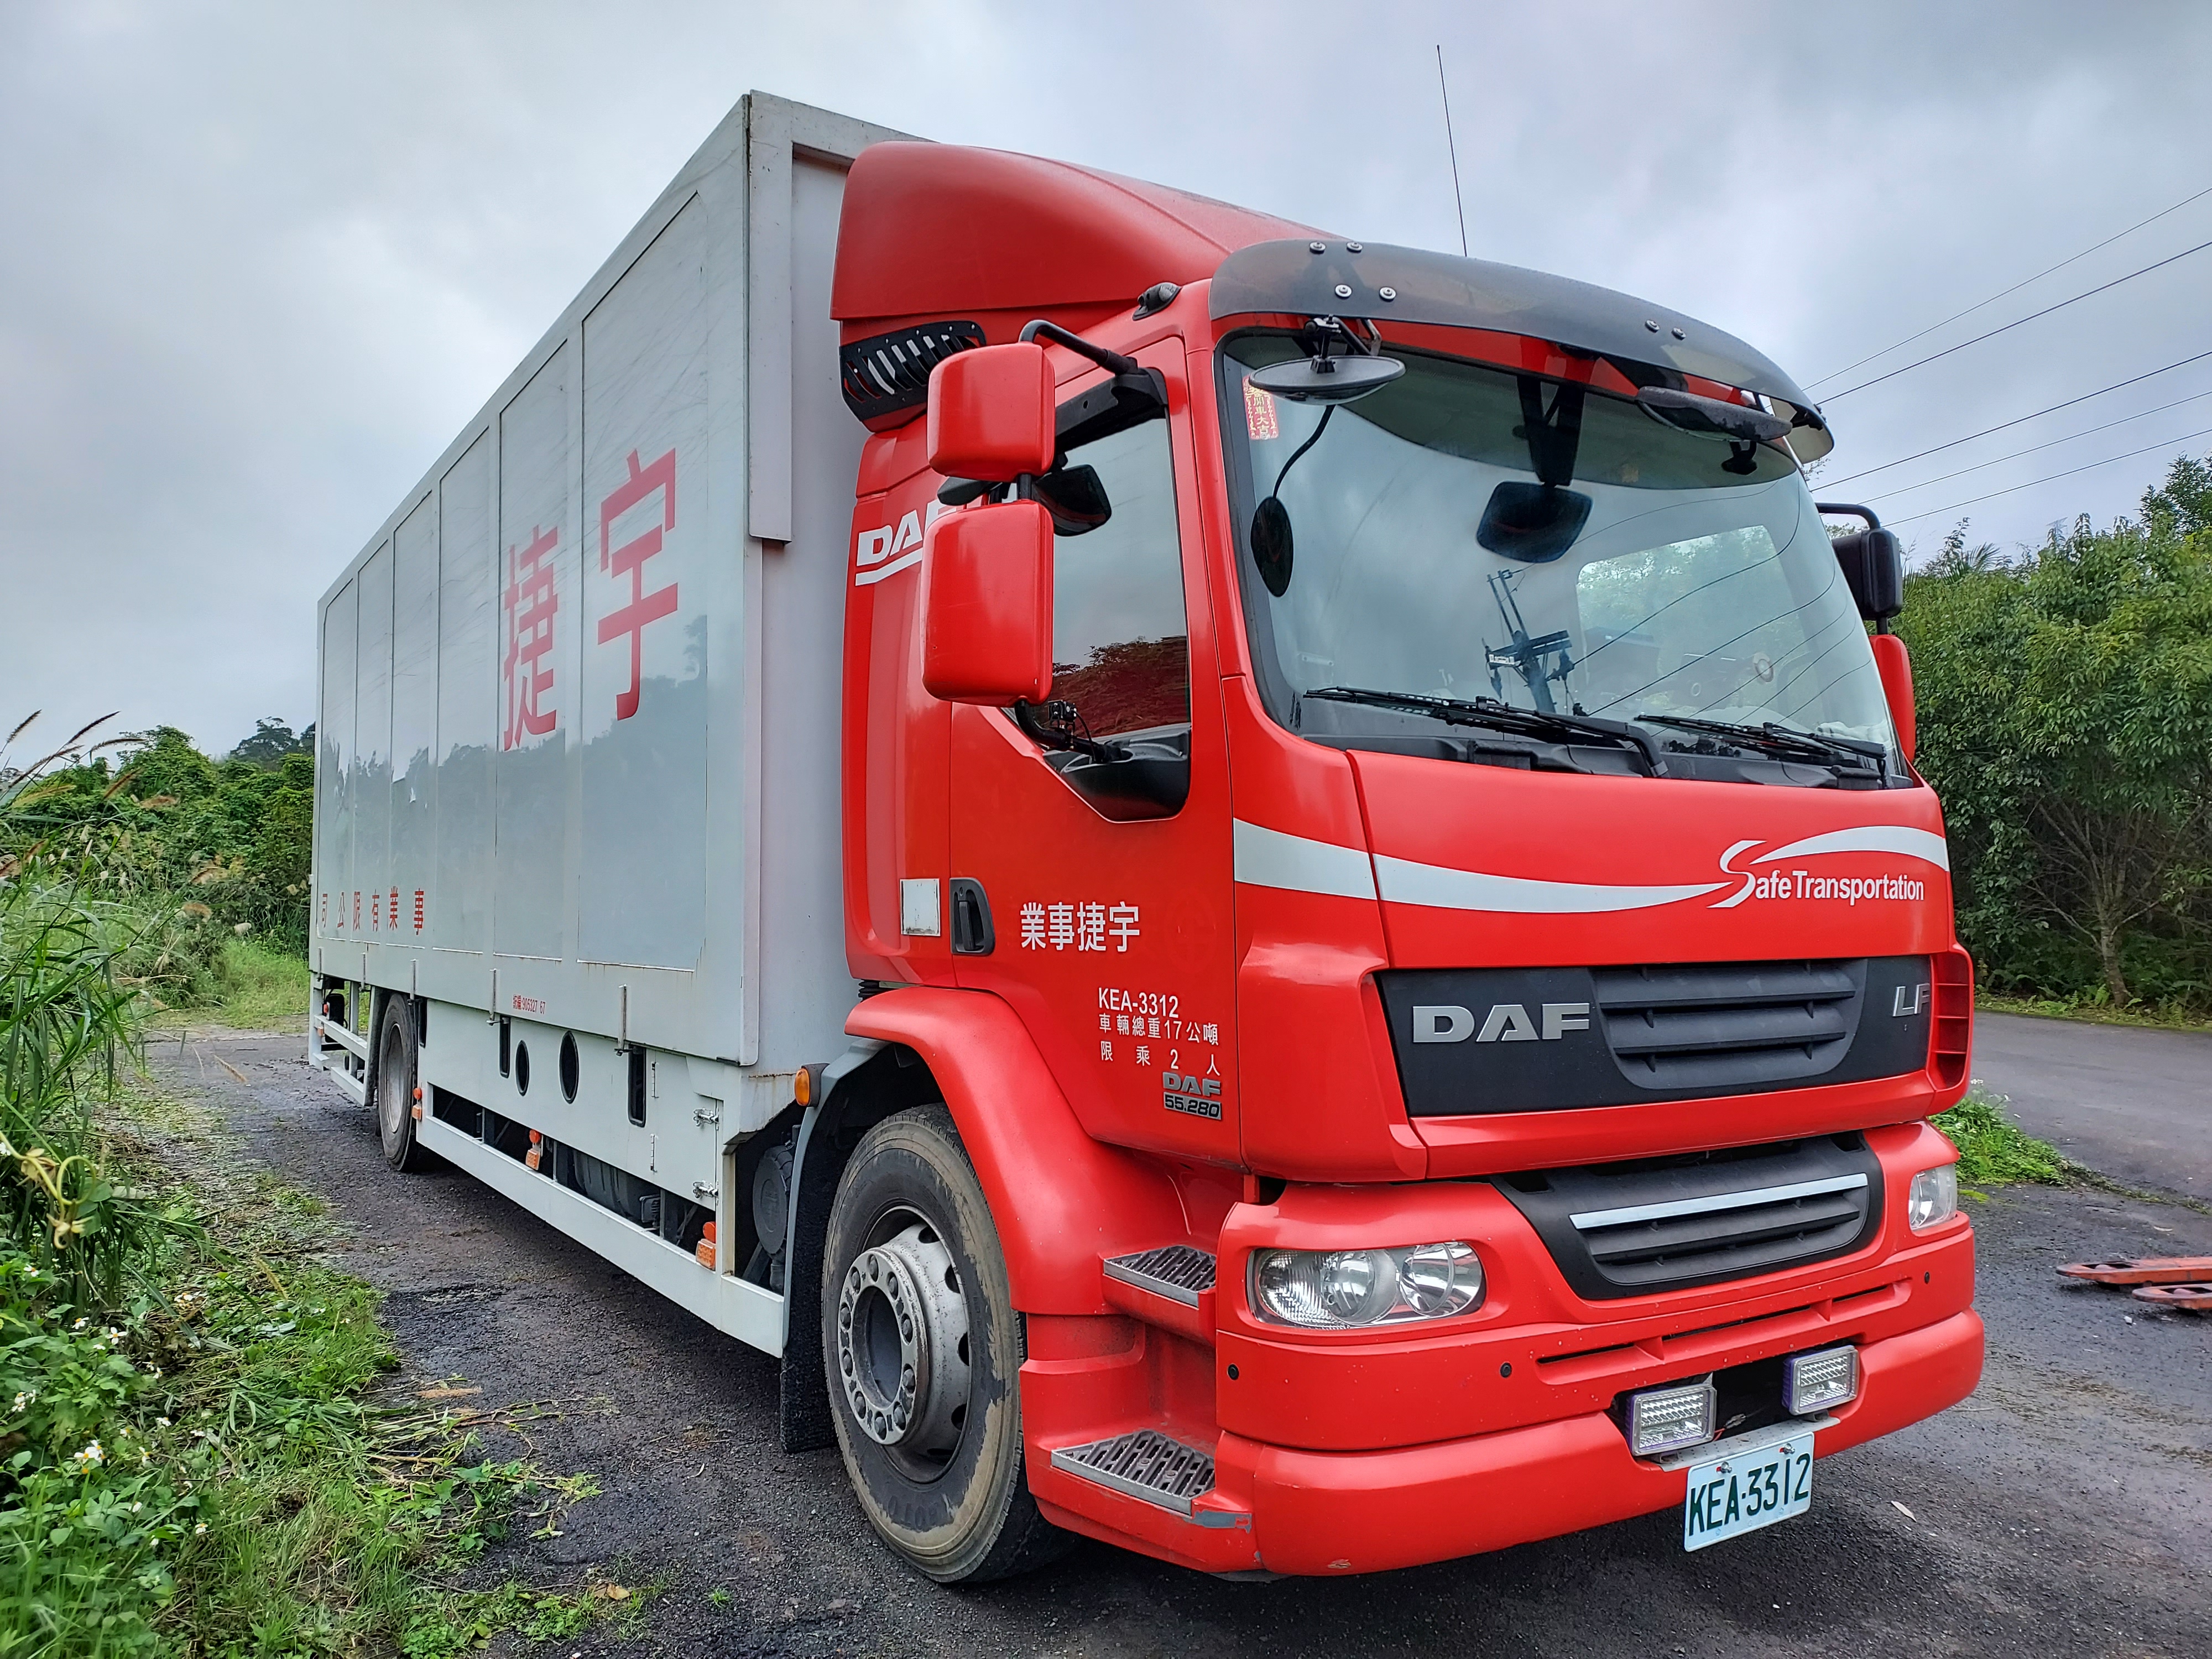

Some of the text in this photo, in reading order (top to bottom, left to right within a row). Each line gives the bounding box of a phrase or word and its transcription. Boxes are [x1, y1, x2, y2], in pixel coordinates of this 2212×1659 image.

[1098, 987, 1179, 1019] KEA-3312
[1892, 983, 1931, 1017] LF
[1412, 1002, 1590, 1044] DAF
[1162, 1071, 1221, 1097] DAF
[1165, 1094, 1220, 1118] 55.280
